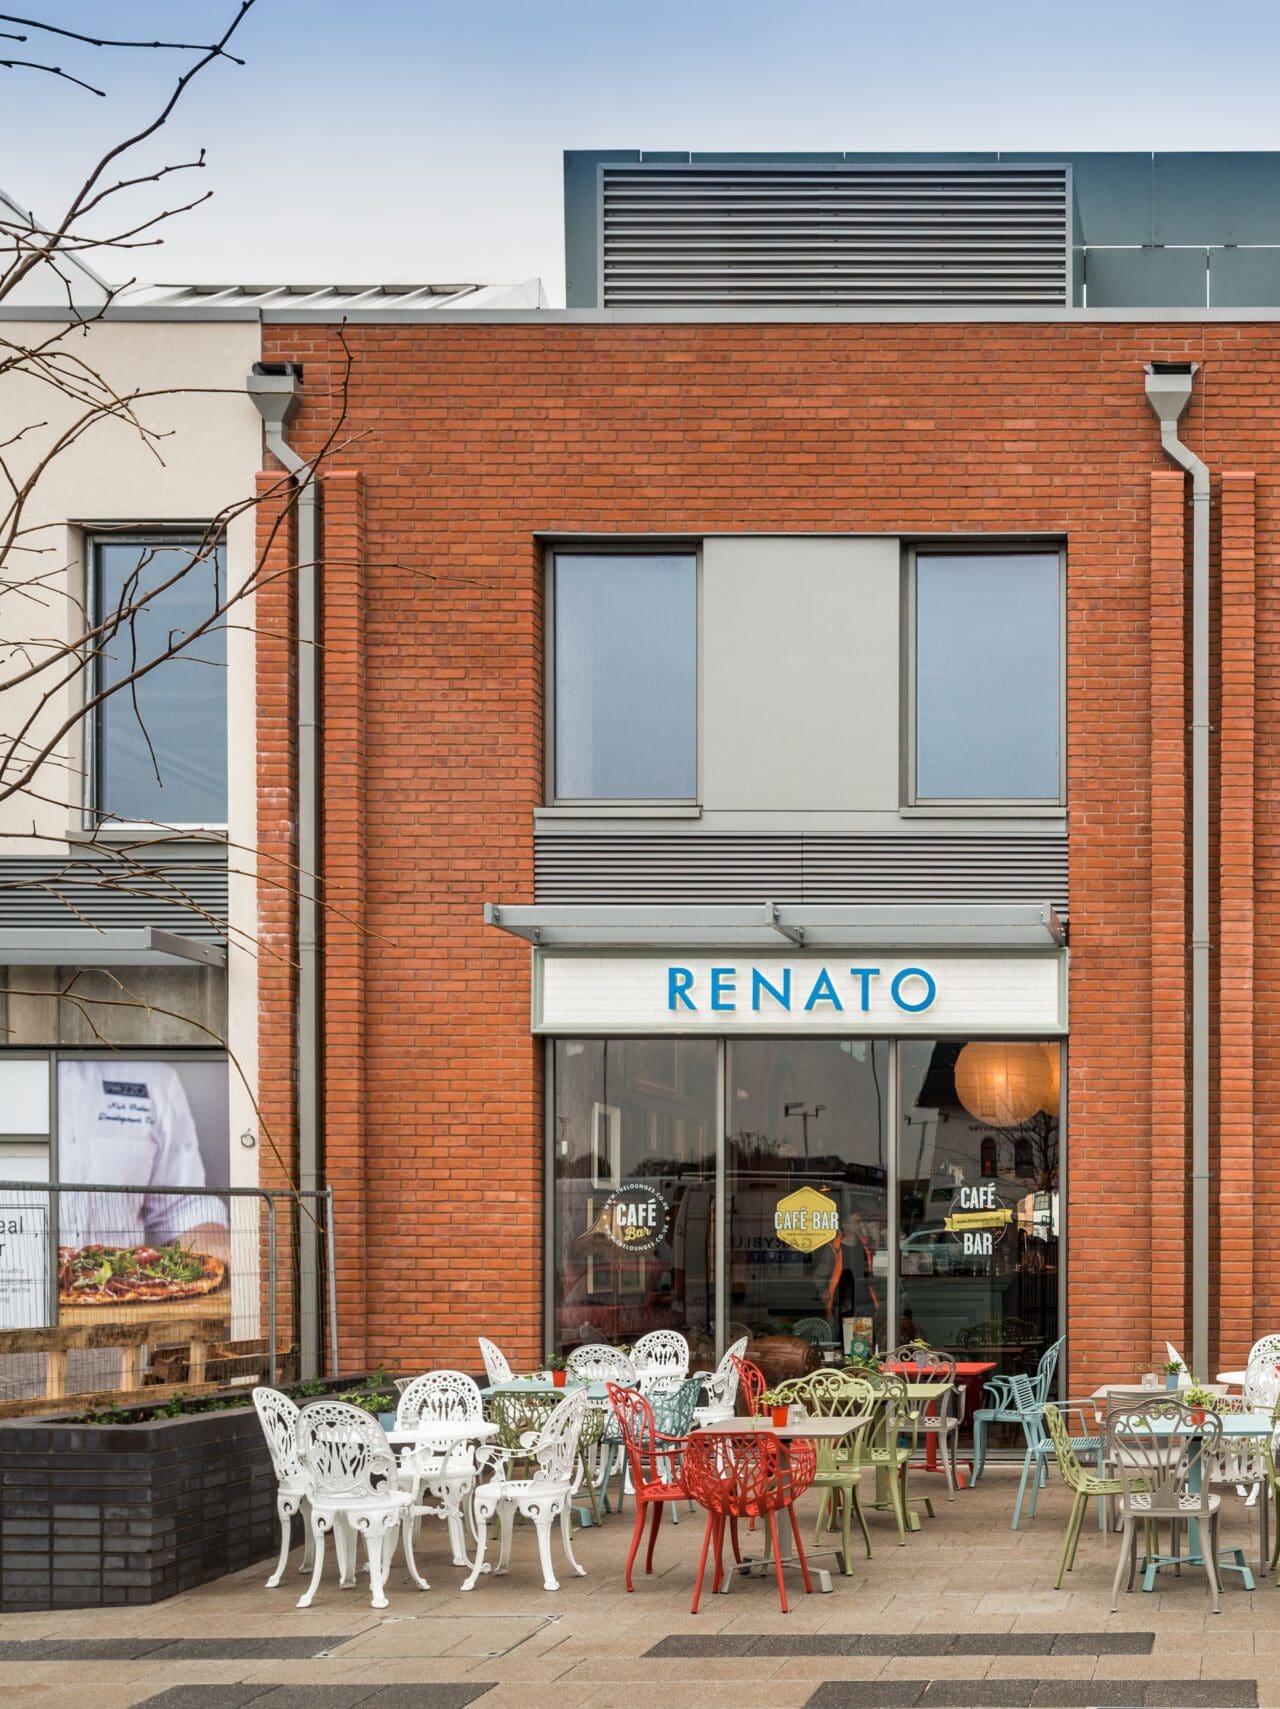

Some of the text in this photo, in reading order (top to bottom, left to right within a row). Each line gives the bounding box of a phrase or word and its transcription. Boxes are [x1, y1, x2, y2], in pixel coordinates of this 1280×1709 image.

[667, 966, 937, 1013] RENATO
[960, 1183, 996, 1209] CAFÉ
[617, 1198, 656, 1226] CAFÉ
[774, 1206, 839, 1230] CAFÉ BAR
[624, 1227, 652, 1241] Bar
[964, 1233, 993, 1255] BAR
